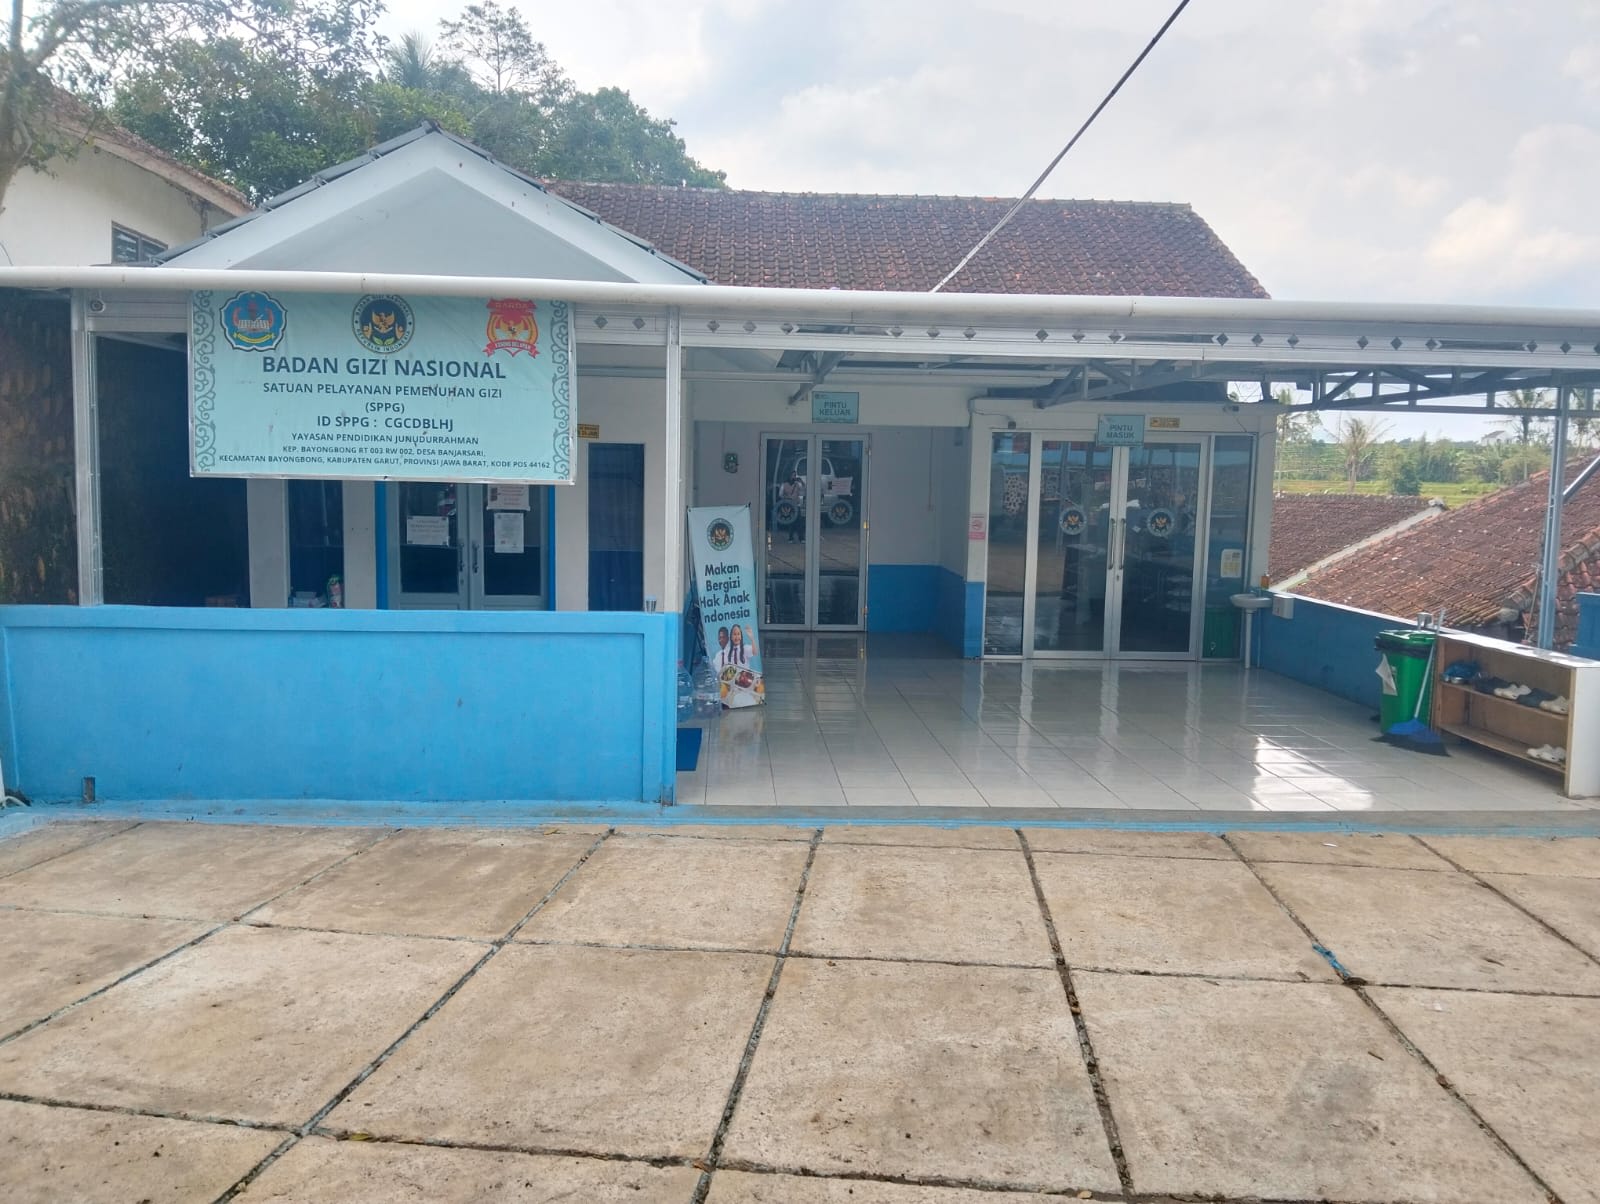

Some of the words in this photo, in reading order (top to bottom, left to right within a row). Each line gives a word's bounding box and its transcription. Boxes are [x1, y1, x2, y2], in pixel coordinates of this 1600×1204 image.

[263, 356, 338, 374] BADAN
[346, 358, 387, 375] GIZI
[394, 359, 506, 379] NASIONAL
[263, 382, 313, 393] SATUAN
[317, 383, 391, 395] PELAYANAN
[395, 385, 475, 397] PEMENUHAN
[478, 388, 502, 398] GIZI
[365, 401, 405, 414] (SPPG)
[819, 408, 850, 416] KELUAR
[317, 415, 331, 427] ID
[335, 416, 369, 428] SPPG
[384, 417, 454, 433] CGCDBLHJ
[292, 433, 334, 441] YAYASAN
[336, 433, 392, 442] PENDIDIKAN
[394, 434, 479, 445] JUNUDURRAHMAN
[301, 446, 357, 454] BAYONGBONG
[268, 455, 325, 464] BAYONGBONG,
[327, 456, 372, 464] KABUPATEN
[374, 457, 402, 465] GARUT,
[440, 459, 460, 467] JAWA
[462, 460, 488, 468] BARAT,
[513, 460, 527, 468] POS
[705, 562, 739, 576] Makan
[706, 576, 740, 592] Bergizi
[700, 594, 720, 608] Hak
[723, 591, 750, 605] Anak
[704, 606, 750, 623] ndonesia
